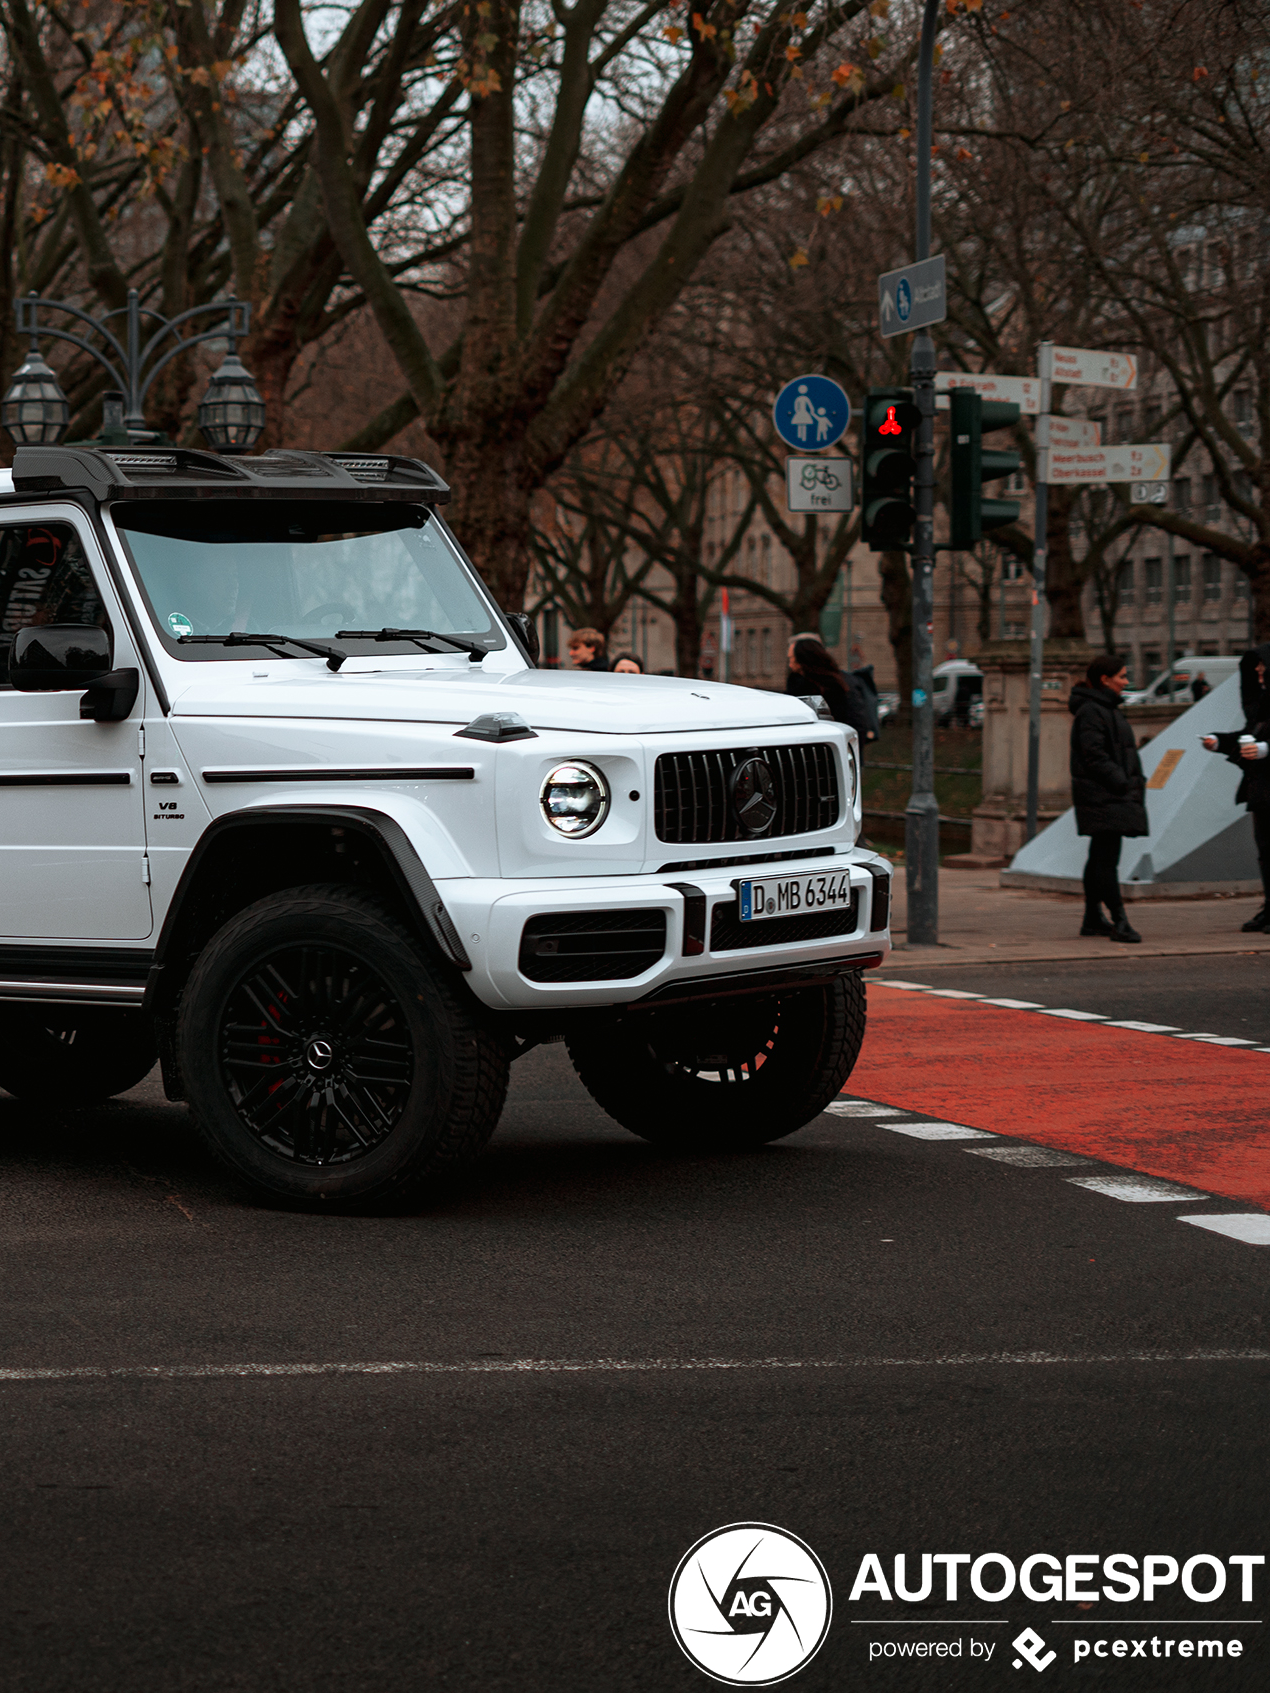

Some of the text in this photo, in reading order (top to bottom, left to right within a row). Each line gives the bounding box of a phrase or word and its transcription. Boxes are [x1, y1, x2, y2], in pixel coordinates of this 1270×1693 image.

[1053, 452, 1106, 463] Meerbusch
[1053, 466, 1107, 478] Oberkassel
[811, 493, 831, 506] frei
[158, 802, 178, 811] V8
[805, 874, 848, 907] 6344
